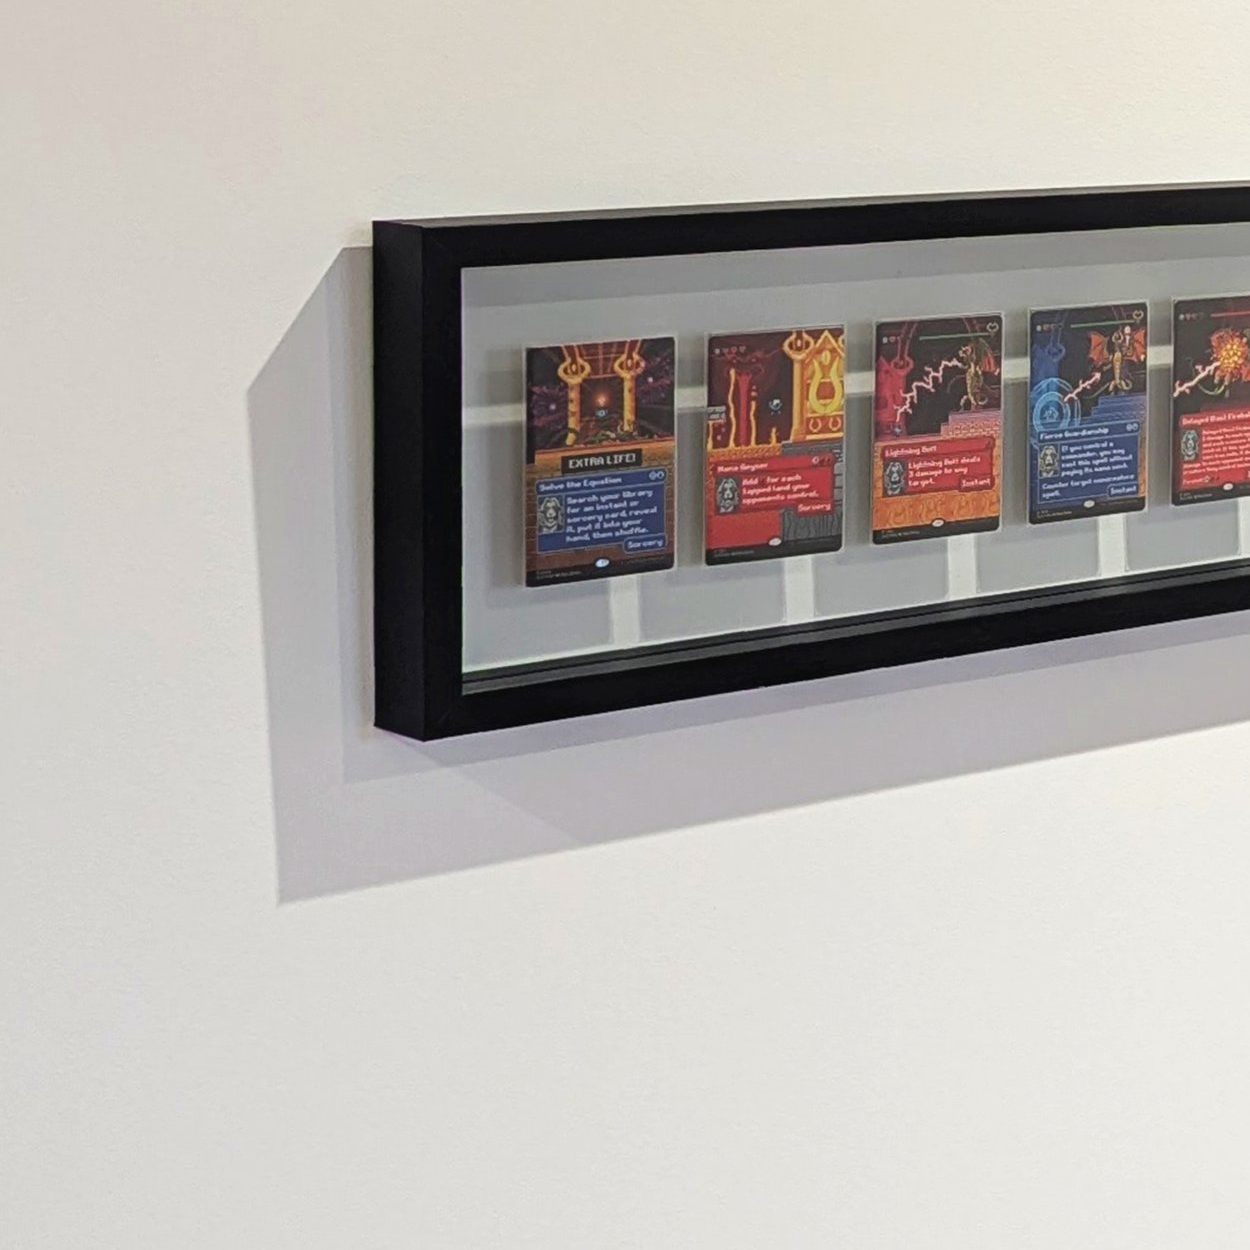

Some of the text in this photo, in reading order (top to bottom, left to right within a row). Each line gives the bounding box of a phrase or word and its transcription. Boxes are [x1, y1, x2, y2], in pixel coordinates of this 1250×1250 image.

[1182, 413, 1210, 426] Delayed
[1063, 427, 1109, 438] Guardianship
[884, 445, 938, 458] Lightning Bolt
[568, 456, 605, 469] EXTRA
[907, 460, 943, 471] Lightning
[960, 455, 981, 465] deals
[780, 473, 802, 483] each
[915, 468, 943, 478] damage
[566, 480, 581, 489] the
[583, 477, 622, 488] Equation
[961, 477, 992, 488] Instant
[1110, 485, 1137, 496] Instant
[566, 494, 599, 504] Search
[600, 493, 620, 503] your
[566, 506, 581, 514] for
[596, 499, 628, 511] instant
[628, 505, 658, 516] reveal
[797, 502, 832, 513] Sorcery
[627, 538, 664, 549] Sorcery
